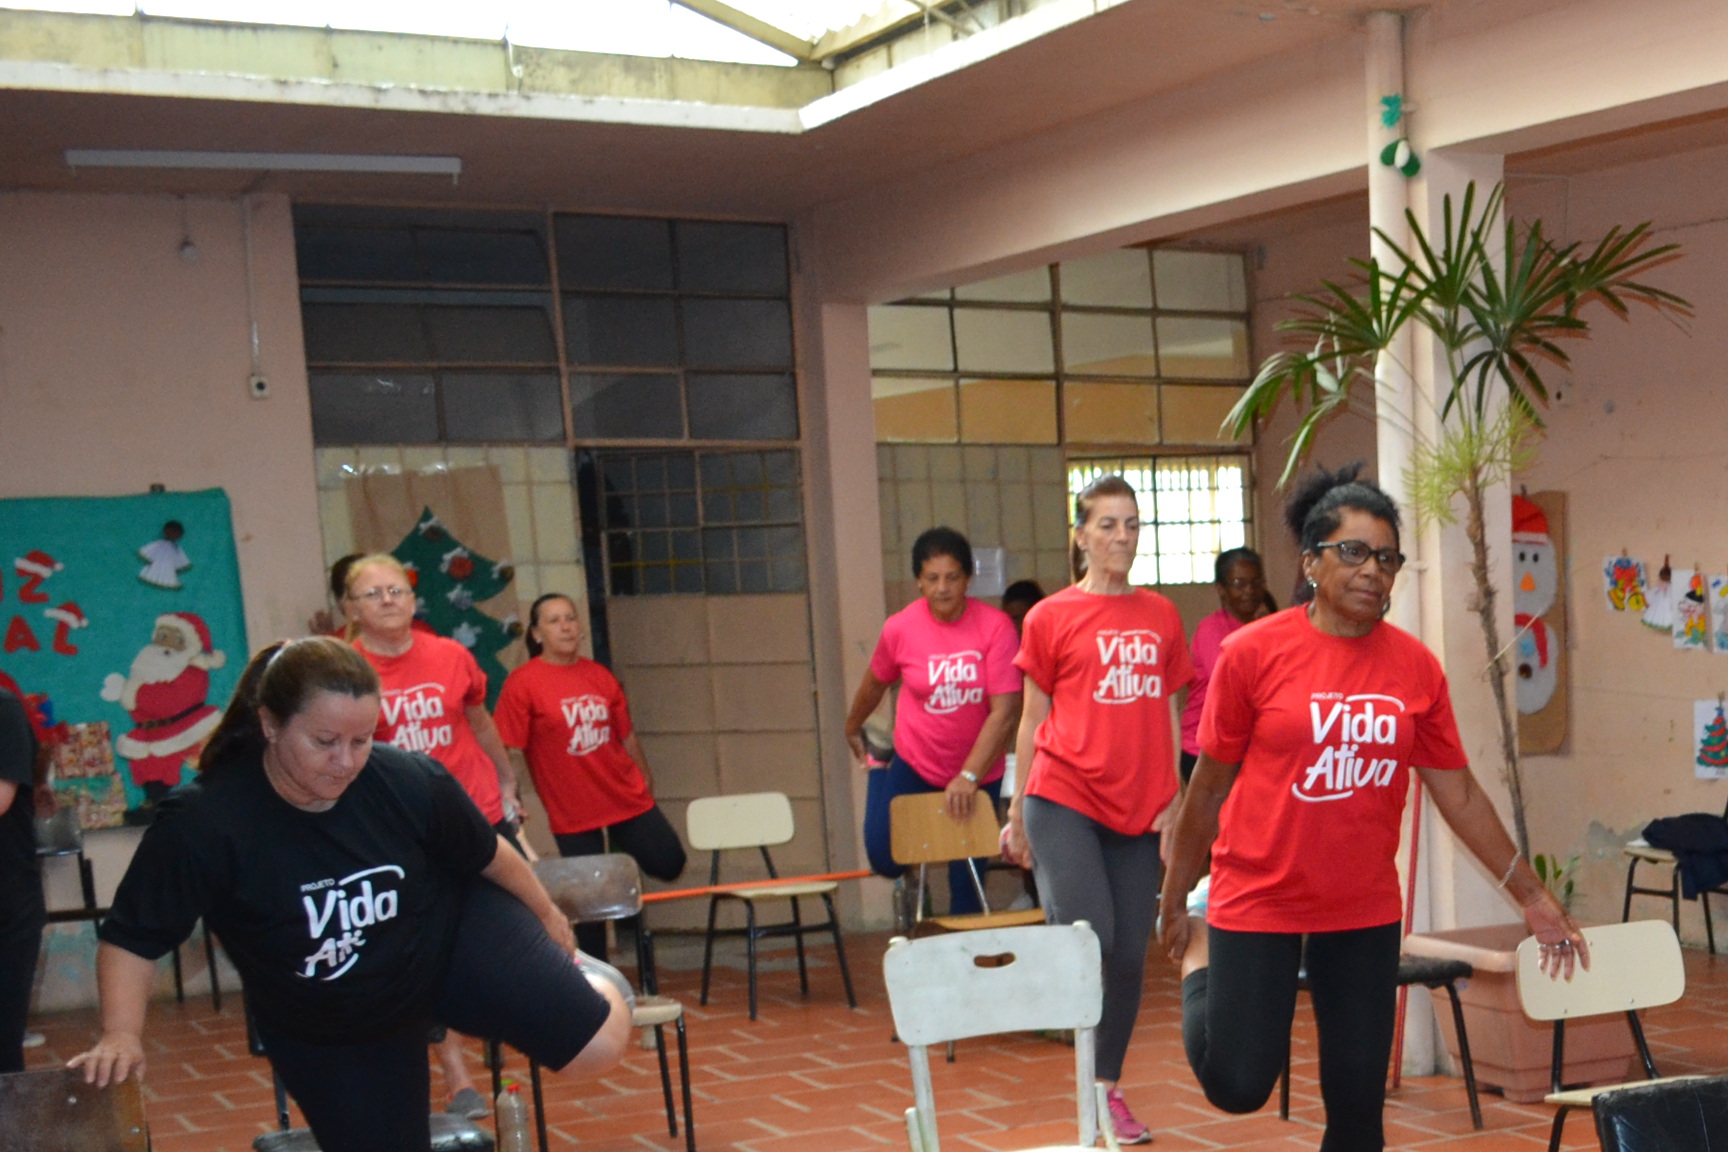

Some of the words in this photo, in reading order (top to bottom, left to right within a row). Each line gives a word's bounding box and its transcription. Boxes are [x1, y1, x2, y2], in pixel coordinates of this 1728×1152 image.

[1096, 634, 1158, 666] Vida
[928, 657, 977, 686] Vida
[1098, 664, 1162, 699] Ativa
[380, 691, 444, 726] Vida
[929, 682, 984, 708] Ativa
[561, 699, 608, 729] Vida
[1309, 701, 1397, 744] Vida
[390, 722, 452, 752] Ativa
[1303, 743, 1398, 790] Ativa
[300, 878, 336, 892] PROJETO
[302, 880, 398, 939] Vida
